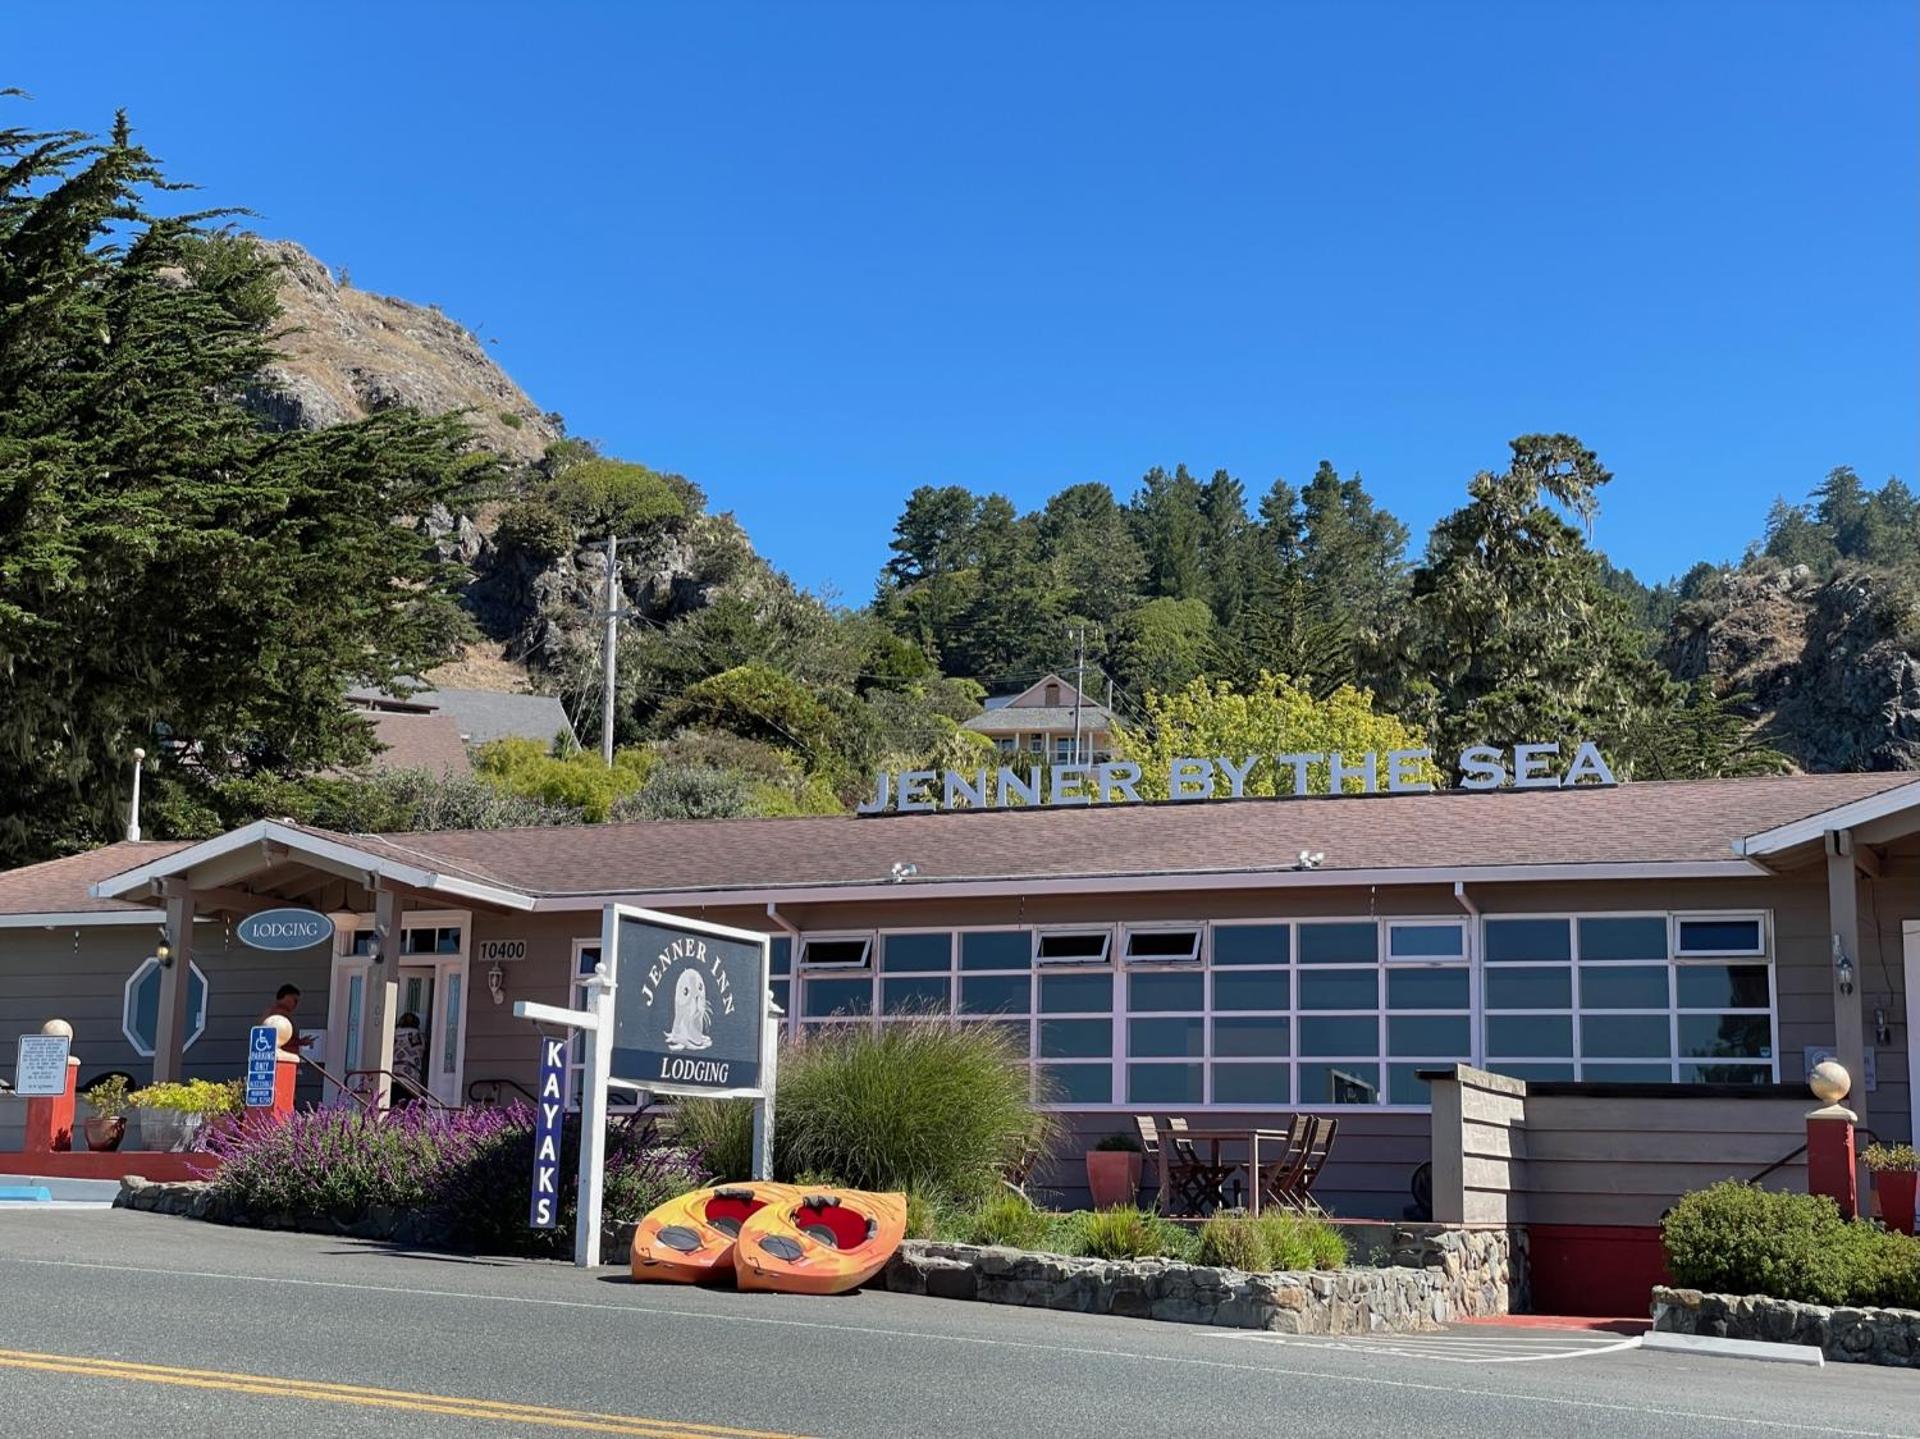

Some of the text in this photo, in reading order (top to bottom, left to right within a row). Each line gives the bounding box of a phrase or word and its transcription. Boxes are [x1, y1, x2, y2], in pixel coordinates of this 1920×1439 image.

[857, 741, 1617, 813] JENNER BY THE SEA
[253, 922, 318, 937] LODGING
[481, 942, 525, 959] 10400
[641, 938, 736, 1015] JENNER INN
[660, 1057, 729, 1084] LODGING
[536, 1041, 564, 1225] KAYAKS
